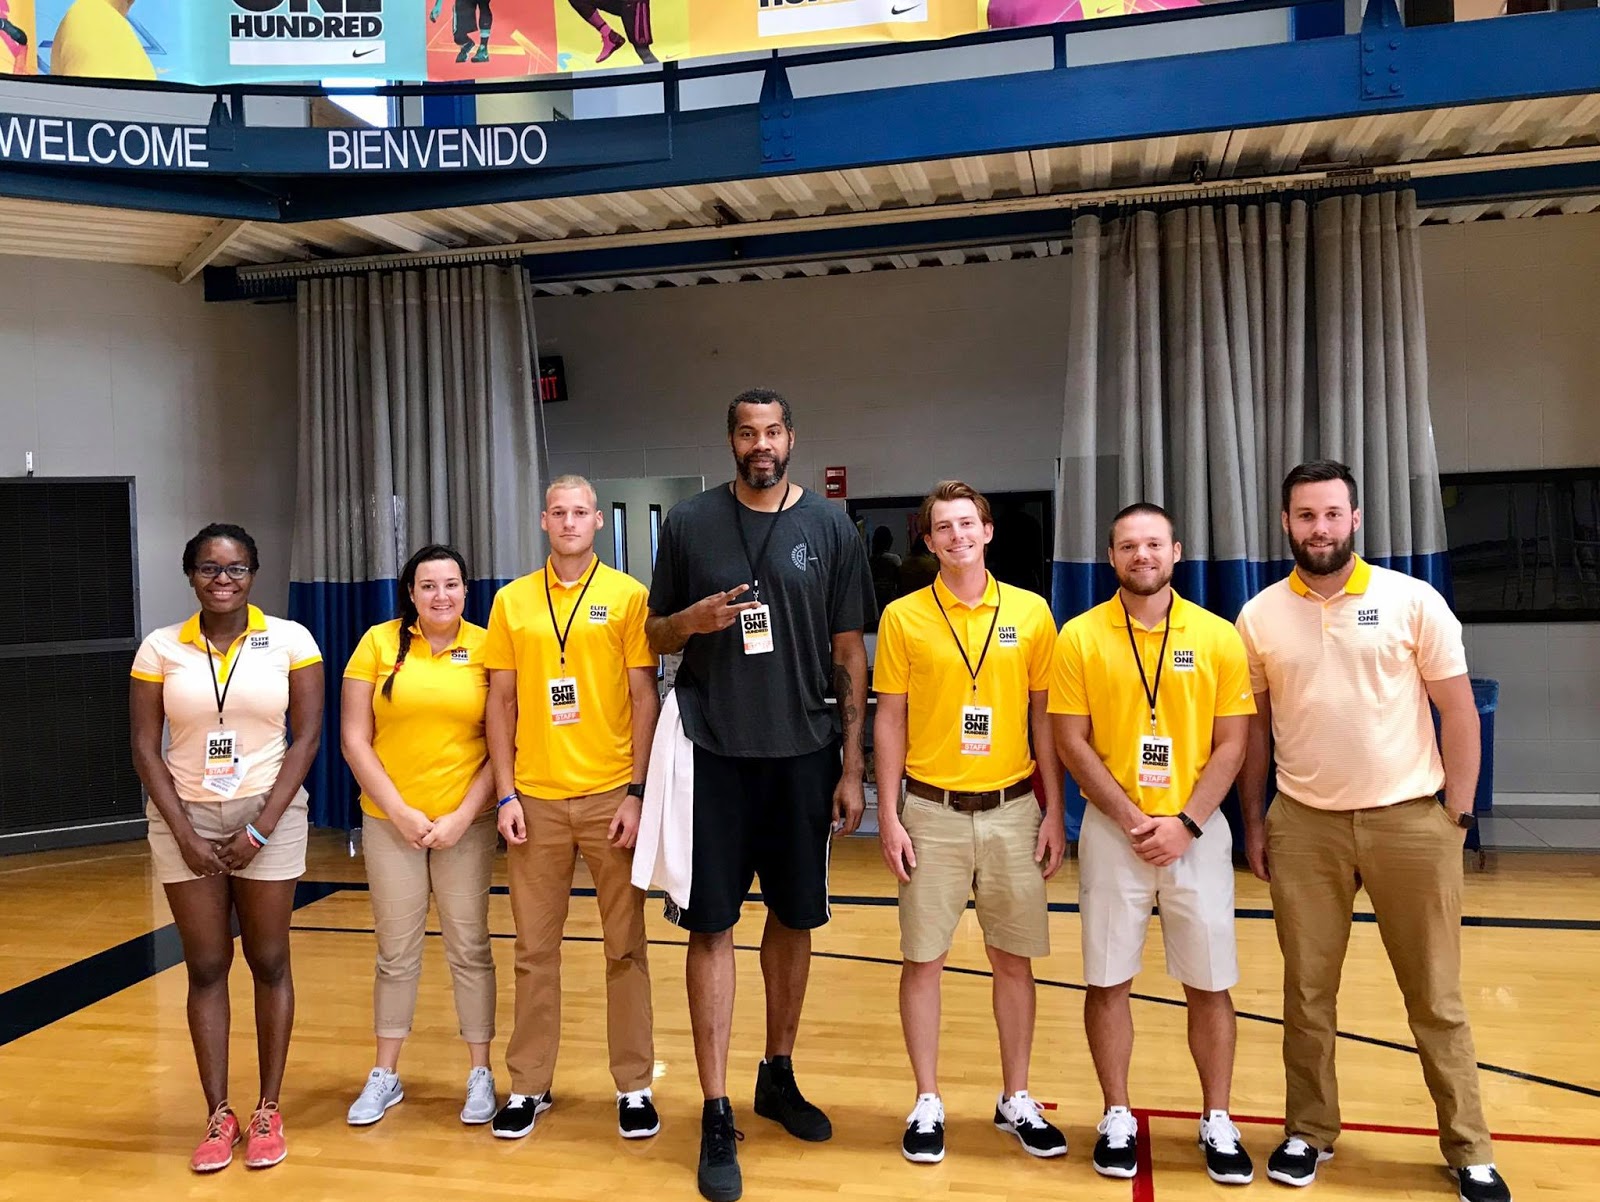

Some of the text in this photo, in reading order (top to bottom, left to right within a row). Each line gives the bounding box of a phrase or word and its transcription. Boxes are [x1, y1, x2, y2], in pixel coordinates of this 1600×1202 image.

[230, 14, 383, 39] HUNDRED
[0, 116, 209, 169] WELCOME
[328, 124, 548, 170] BIENVENIDO
[743, 612, 767, 622] ELITE
[1358, 608, 1379, 616] ELITE
[744, 620, 768, 630] ONE
[551, 684, 575, 694] ELITE
[552, 692, 575, 703] ONE
[554, 712, 577, 721] STAFF
[965, 713, 989, 722] ELITE
[964, 721, 989, 732] ONE
[209, 738, 233, 747] ELITE
[964, 743, 987, 751] STAFF
[209, 746, 232, 756] ONE
[1143, 743, 1169, 753] ELITE
[1142, 752, 1169, 763] ONE
[1142, 774, 1167, 784] STAFF
